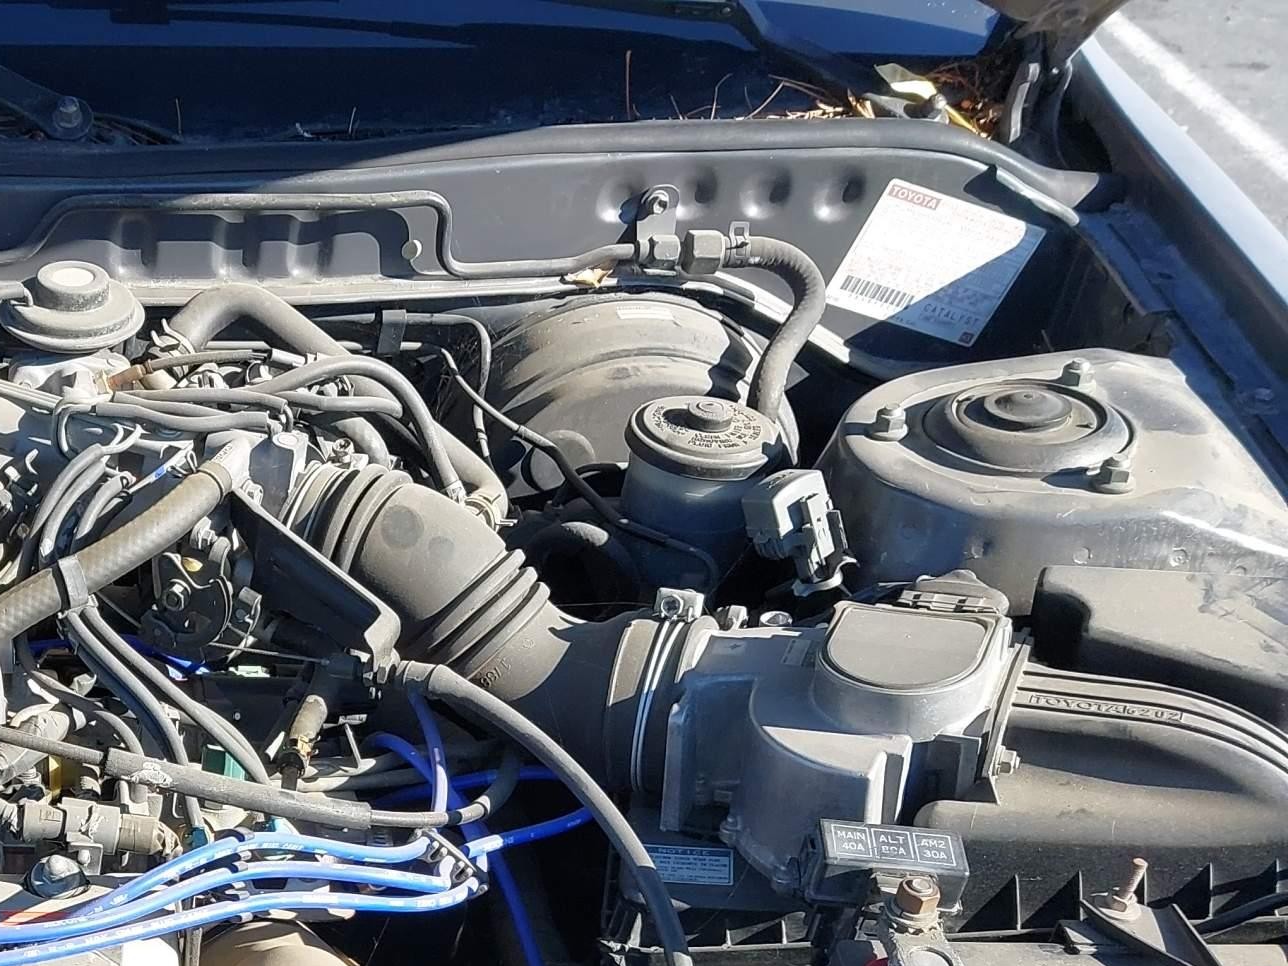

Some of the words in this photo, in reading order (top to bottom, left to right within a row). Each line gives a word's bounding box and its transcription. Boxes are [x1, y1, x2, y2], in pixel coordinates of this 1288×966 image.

[892, 184, 938, 210] TOYOTA
[922, 302, 980, 328] CATALYST
[837, 829, 866, 841] MAIN
[879, 834, 905, 845] ALT
[841, 841, 865, 851] 40A
[920, 838, 947, 849] AM2
[923, 849, 948, 860] 30A
